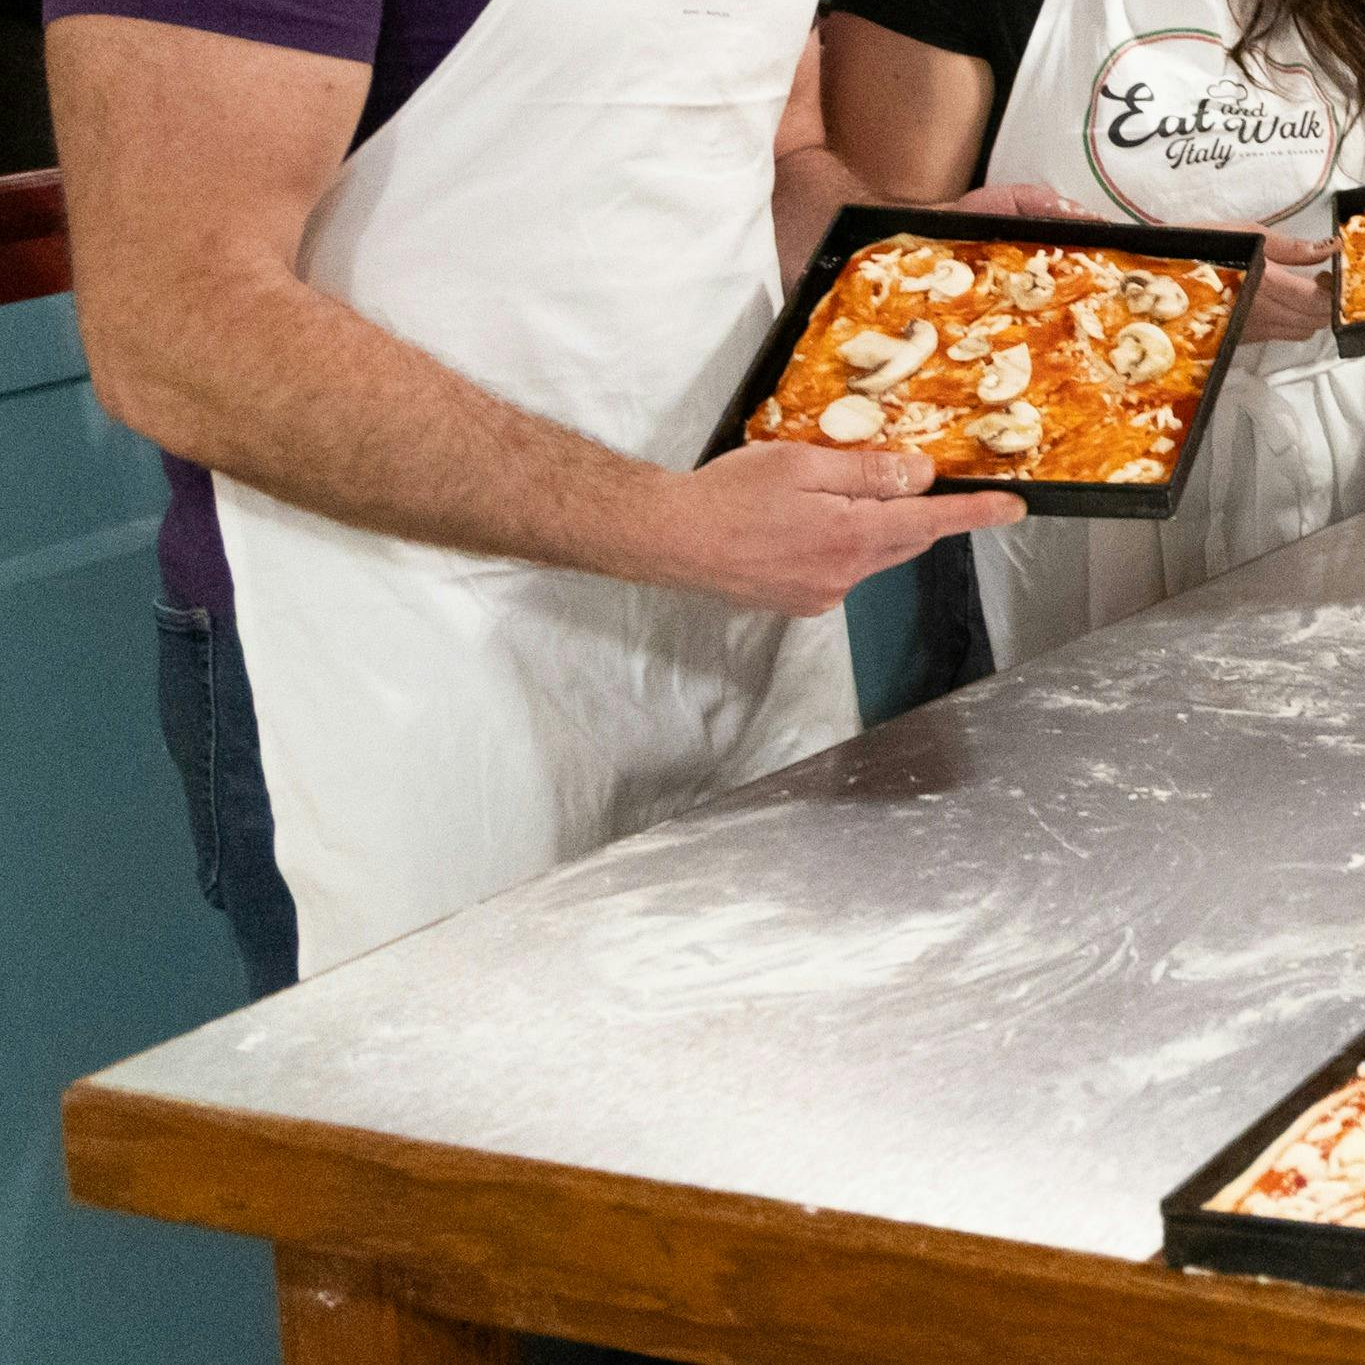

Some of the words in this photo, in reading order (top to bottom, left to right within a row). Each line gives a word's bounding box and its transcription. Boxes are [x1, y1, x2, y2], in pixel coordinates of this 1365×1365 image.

[1100, 82, 1215, 148] Eat
[1220, 102, 1268, 118] and
[1223, 110, 1325, 145] Walk
[1165, 136, 1233, 169] Italy
